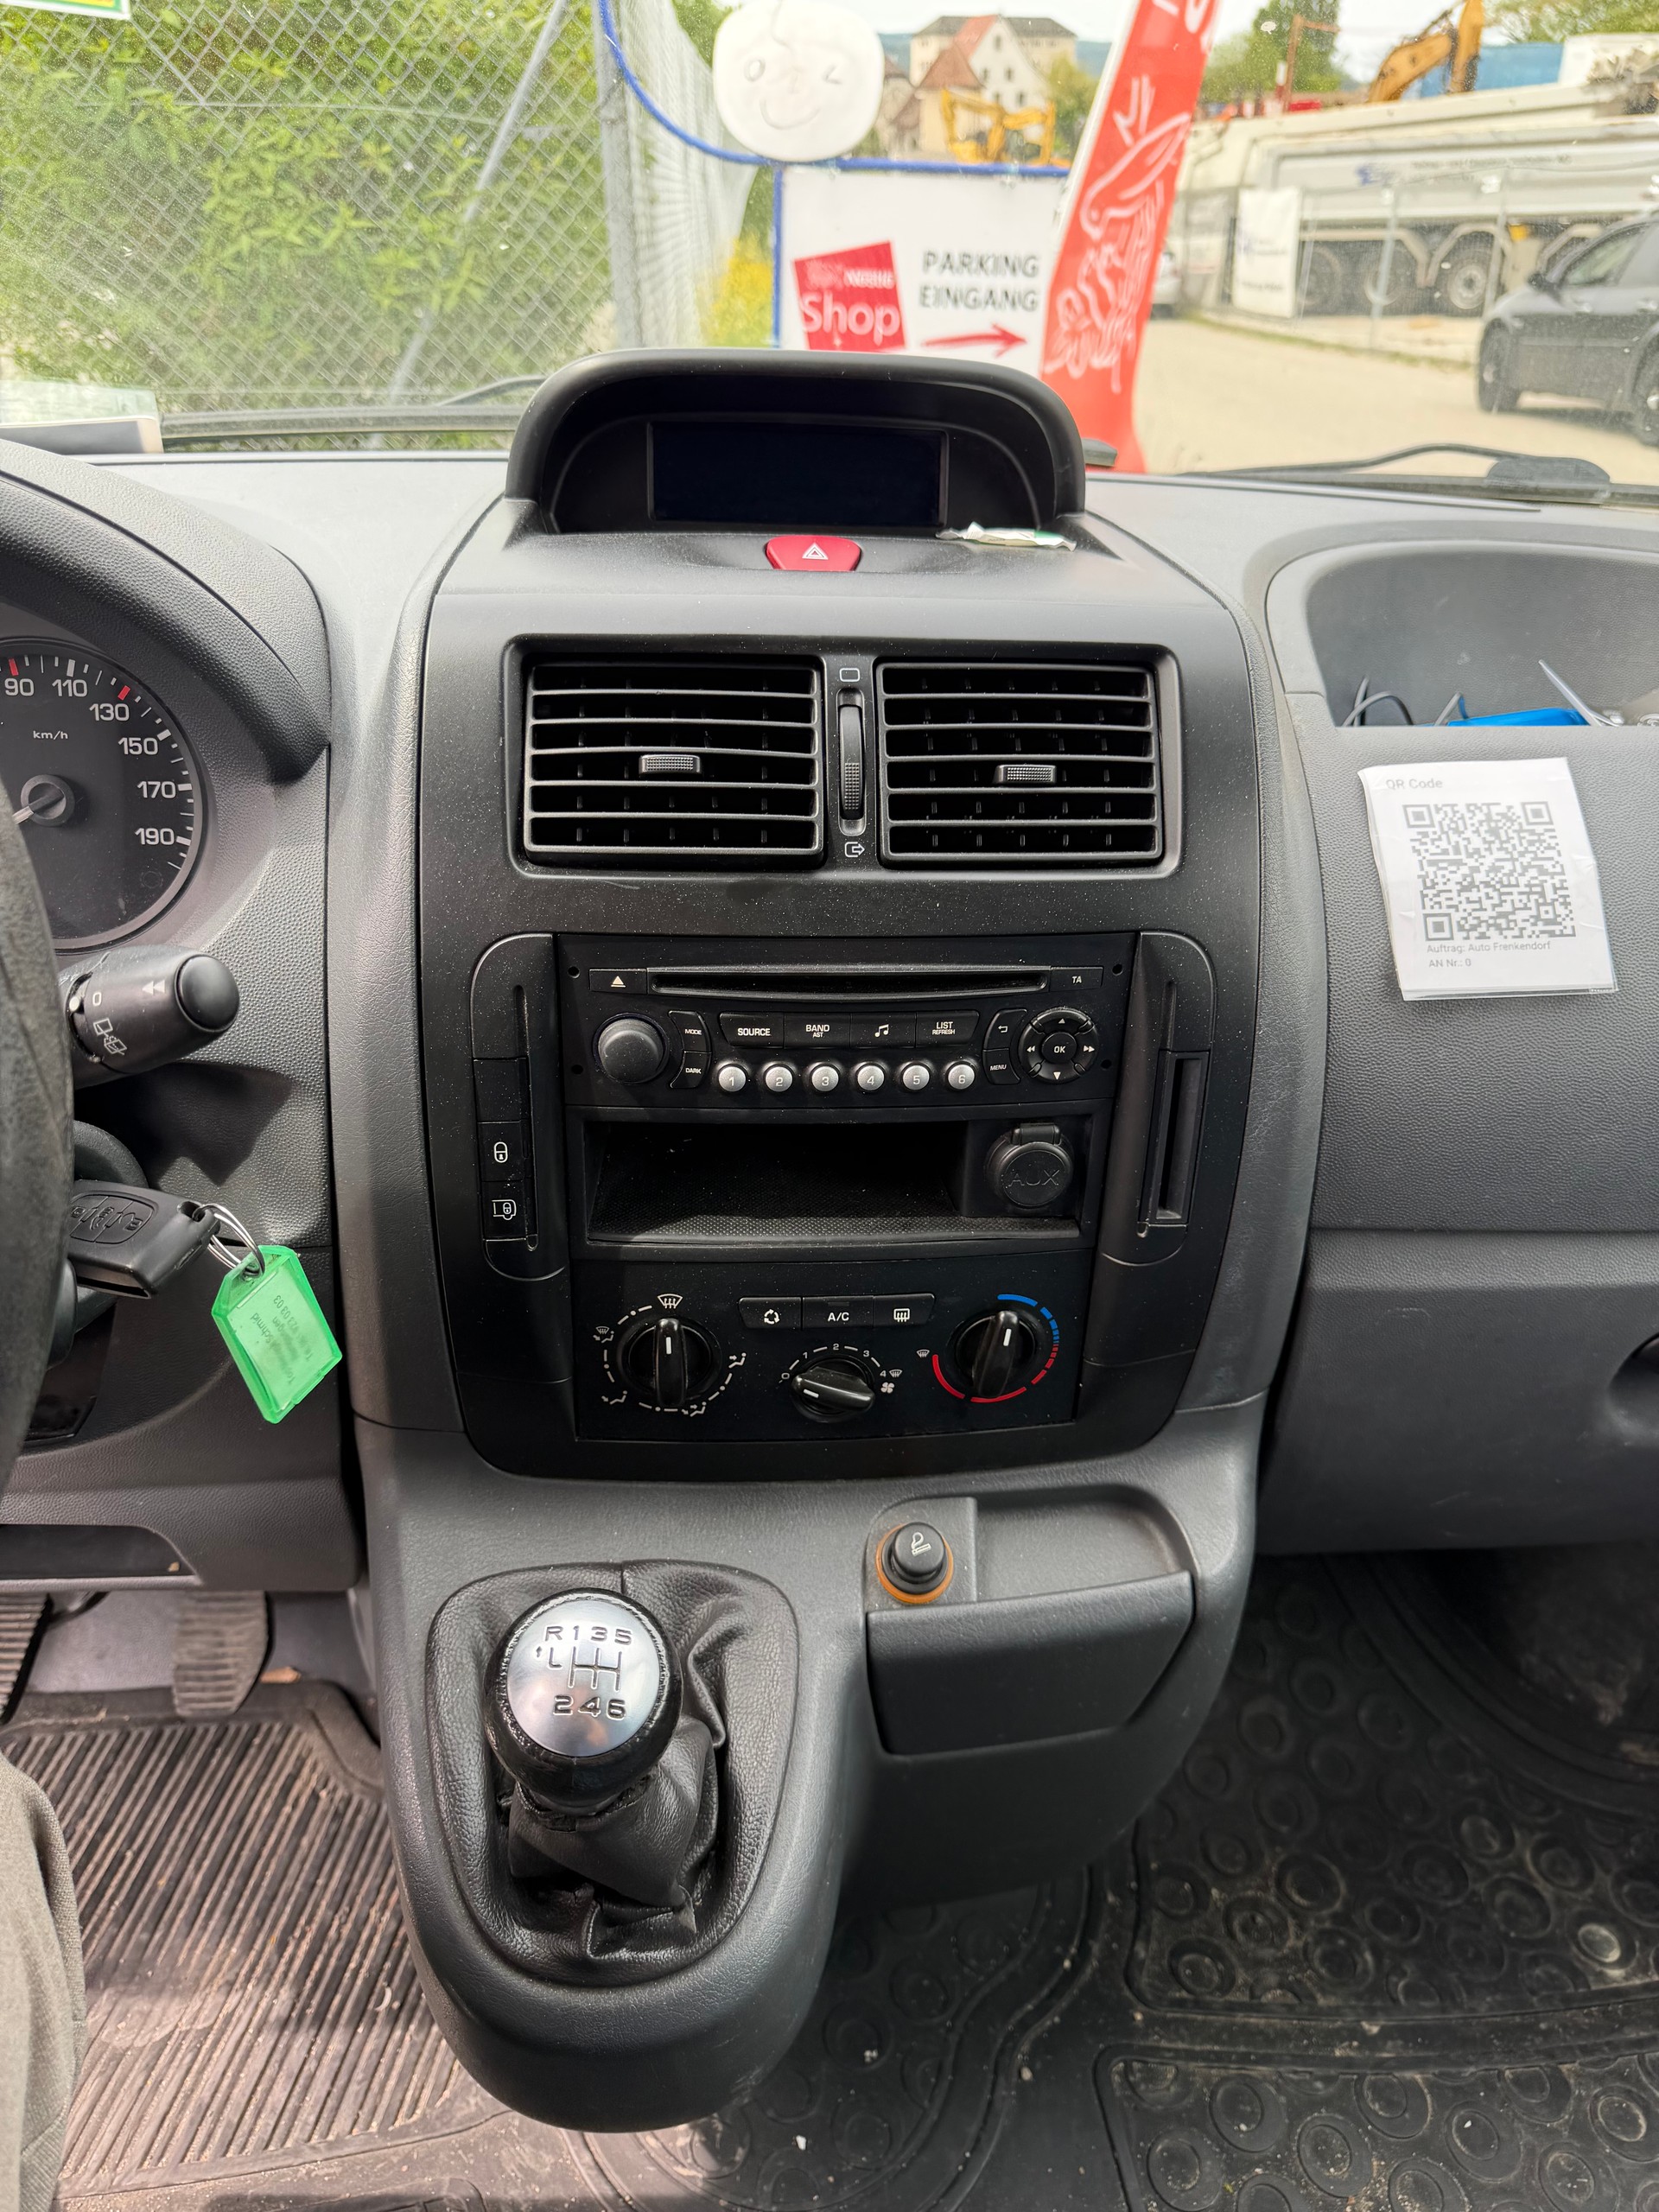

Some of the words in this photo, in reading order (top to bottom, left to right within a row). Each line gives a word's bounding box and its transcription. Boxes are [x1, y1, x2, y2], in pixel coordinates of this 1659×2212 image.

[922, 249, 1039, 277] PARKING
[919, 284, 1039, 313] EINGANG
[800, 289, 901, 346] Shop
[4, 677, 35, 696] 90
[52, 678, 88, 697] 110
[89, 702, 130, 721] 130
[33, 730, 68, 740] km/h
[118, 737, 158, 755] 150
[137, 781, 176, 798] 170
[1385, 779, 1405, 790] QR
[1408, 778, 1443, 789] Code
[134, 828, 175, 845] 190
[1427, 944, 1466, 954] Auftrag:
[1493, 941, 1551, 951] Frenkendorf
[1428, 959, 1444, 968] AN
[737, 1027, 771, 1037] SOURCE
[805, 1024, 830, 1033] BAND
[1053, 1046, 1066, 1054] OK
[728, 1077, 735, 1087] 1
[775, 1077, 784, 1088] 2
[821, 1076, 830, 1087] 3
[867, 1075, 875, 1086] 4
[912, 1075, 921, 1085] 5
[957, 1074, 966, 1085] 6
[1007, 1169, 1060, 1187] AUX
[273, 1294, 283, 1308] 03
[827, 1312, 850, 1322] A/C
[544, 1625, 564, 1642] R
[572, 1624, 580, 1641] 1
[590, 1626, 608, 1642] 3
[613, 1628, 633, 1646] 5
[553, 1694, 574, 1716] 2
[577, 1695, 601, 1718] 4
[606, 1698, 627, 1720] 6
